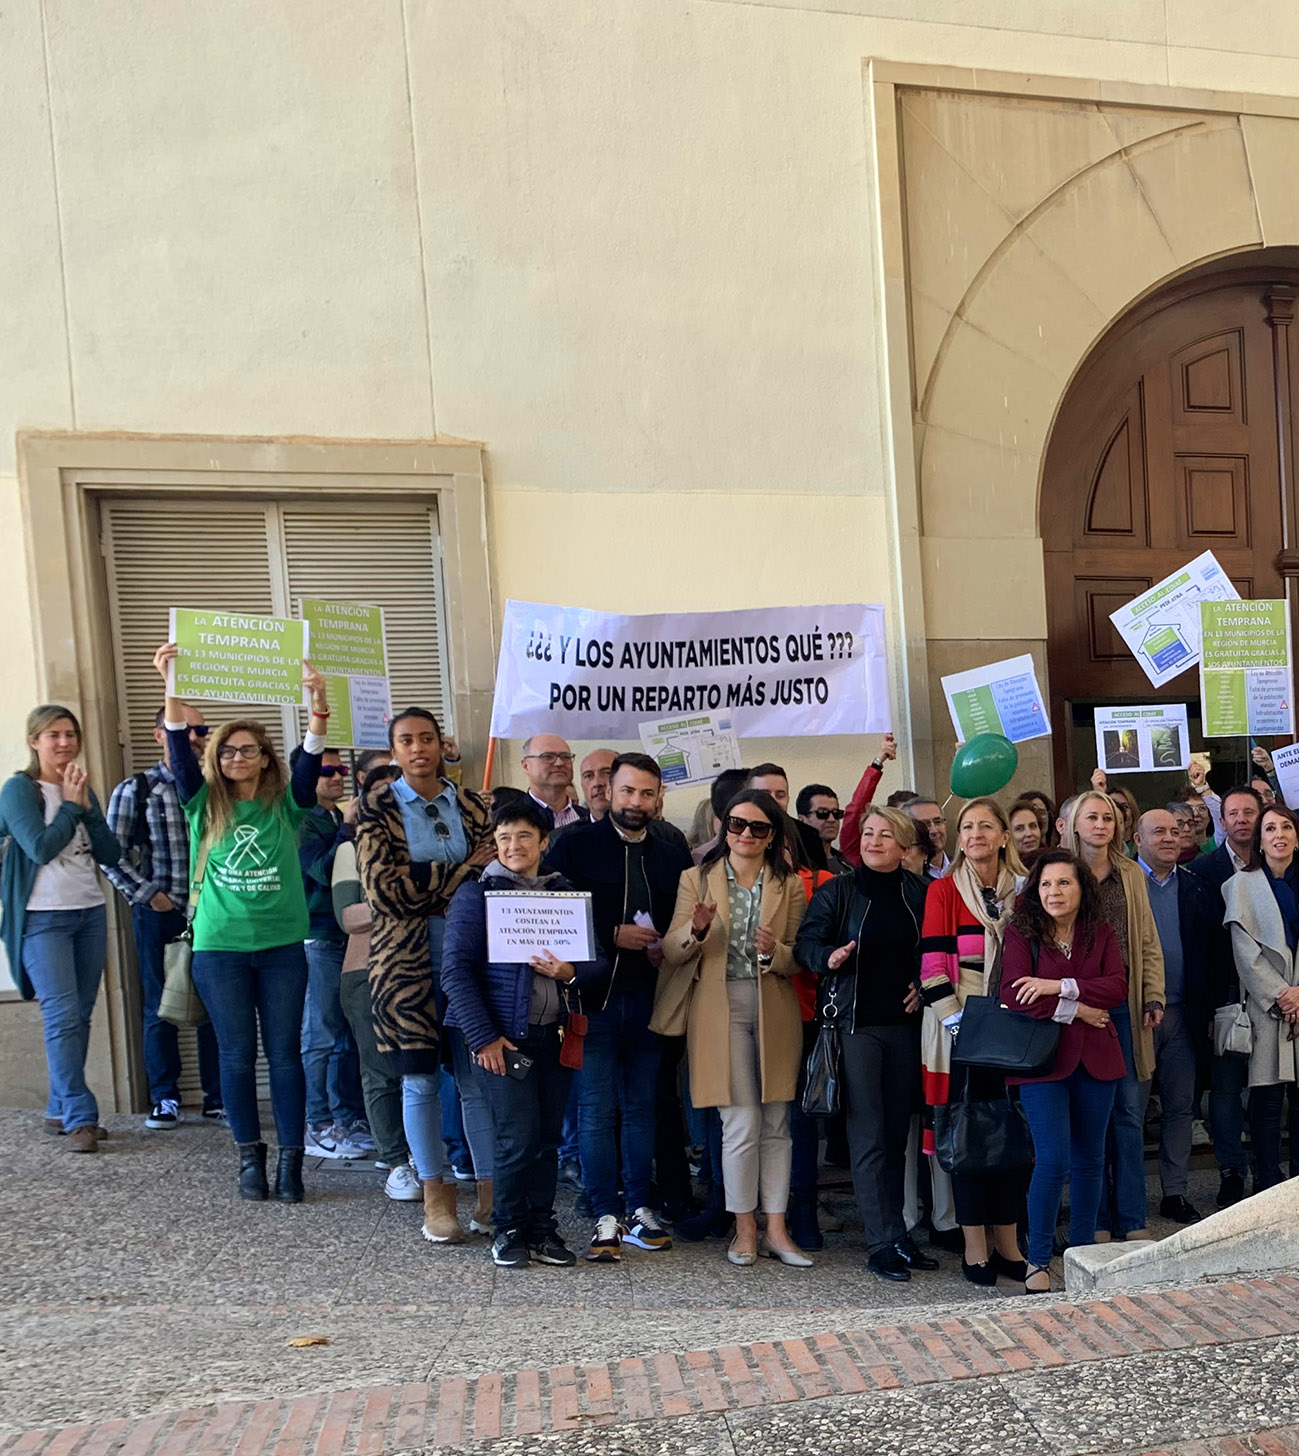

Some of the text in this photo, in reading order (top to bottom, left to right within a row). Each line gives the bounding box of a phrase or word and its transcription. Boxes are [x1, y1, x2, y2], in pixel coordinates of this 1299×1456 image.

[194, 615, 285, 632] LA ATENCIÓN
[318, 618, 369, 632] TEMPRANA
[1217, 617, 1271, 626] TEMPRANA
[198, 633, 280, 650] TEMPRANA
[526, 625, 854, 669] ¿¿¿ Y LOS AYUNTAMIENTOS QUÉ ???
[177, 648, 300, 666] EN 13 MUNICIPIOS DE LA
[1222, 659, 1283, 667] AYUNTAMIENTOS
[190, 661, 288, 677] REGIÓN DE MURCIA
[177, 674, 300, 691] ES GRATUITA GRACIAS A
[181, 688, 296, 704] LOS AYUNTAMIENTOS
[549, 675, 829, 711] POR UN REPARTO MÁS JUSTO
[1277, 750, 1293, 760] ANTE
[499, 927, 536, 935] ATENCIÓN
